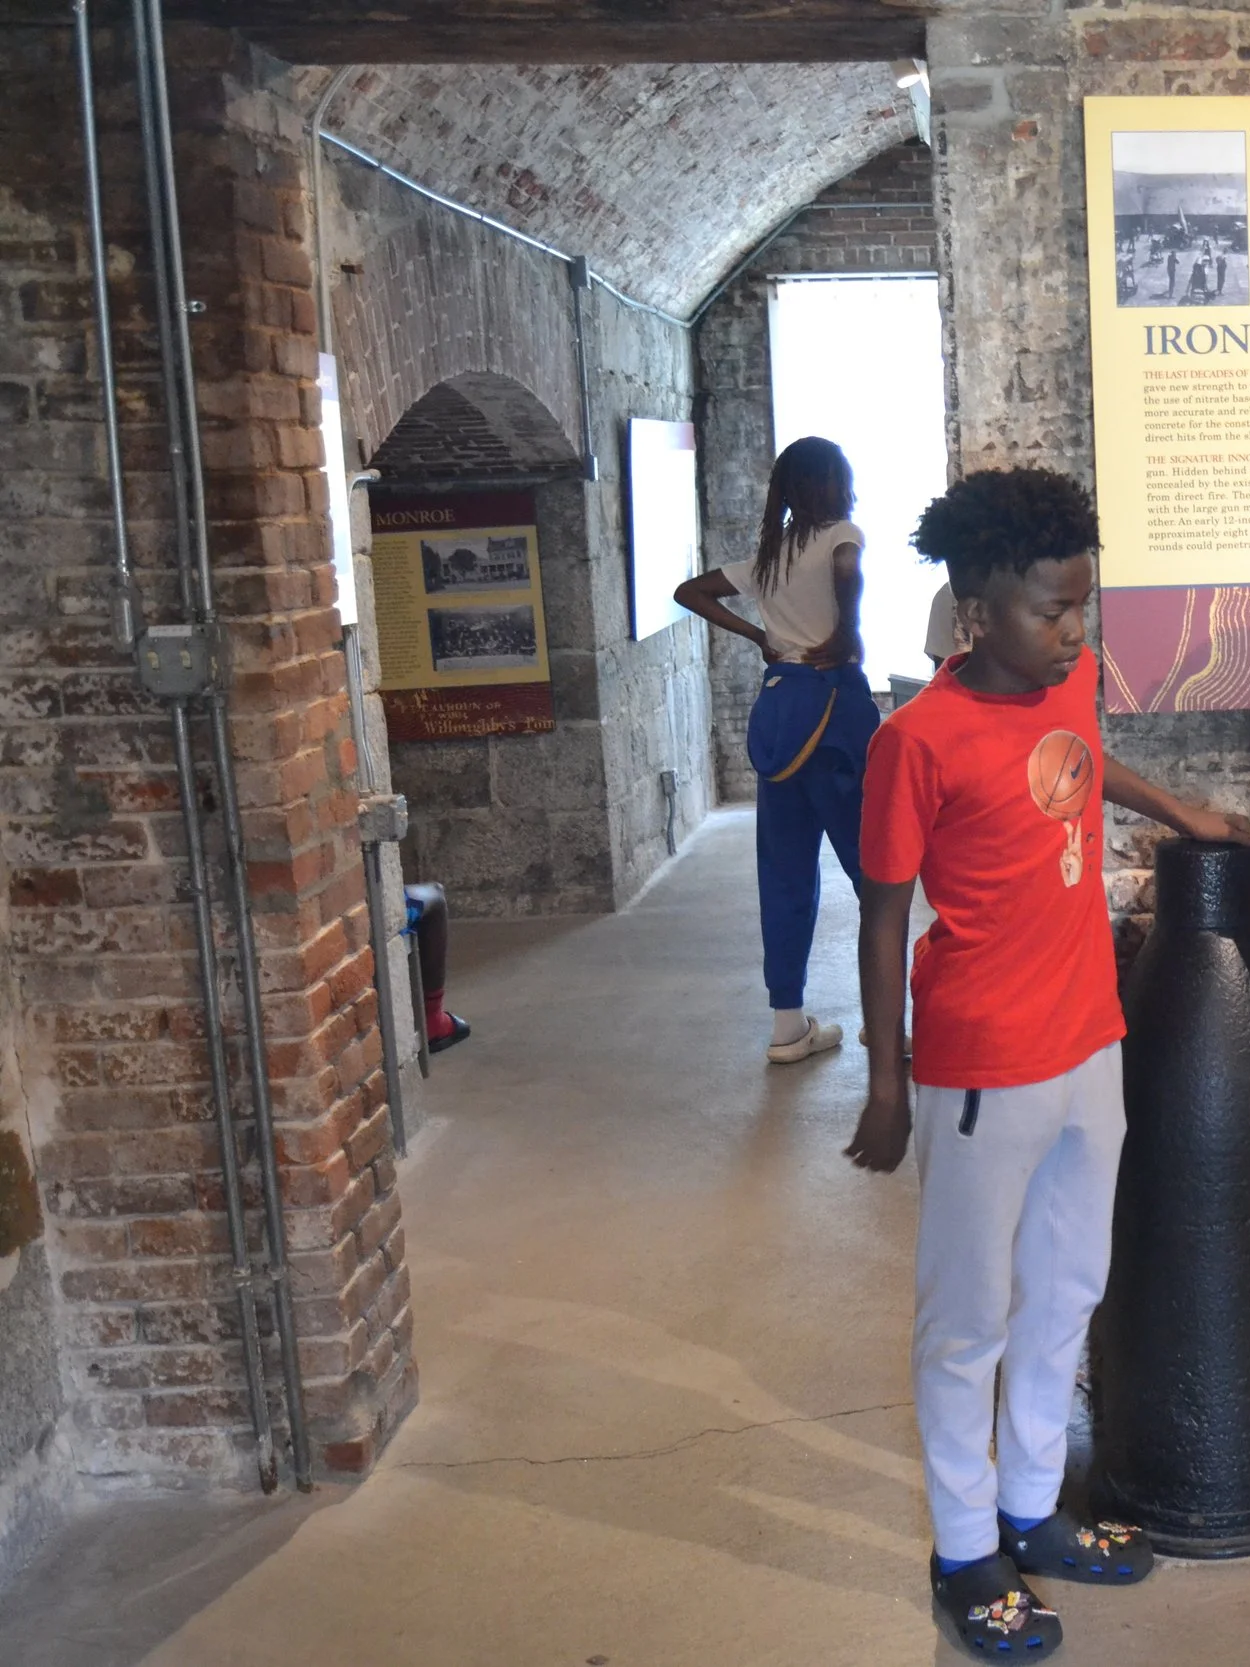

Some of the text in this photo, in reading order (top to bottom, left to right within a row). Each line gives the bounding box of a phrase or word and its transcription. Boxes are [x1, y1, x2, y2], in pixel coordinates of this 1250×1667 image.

[1164, 370, 1188, 378] LAST
[1190, 370, 1234, 378] DECADES
[1235, 369, 1249, 377] OF
[1143, 386, 1167, 395] gave
[1192, 382, 1235, 393] strength
[1144, 396, 1160, 404] the
[1182, 395, 1193, 404] of
[1172, 408, 1215, 416] accurate
[1217, 406, 1236, 415] and
[1188, 420, 1203, 428] for
[1205, 420, 1222, 428] the
[1145, 434, 1174, 442] direct
[1176, 433, 1196, 441] hits
[1199, 432, 1222, 440] from
[1225, 432, 1241, 440] the
[1146, 456, 1166, 464] THE
[1170, 454, 1224, 463] SIGNATURE
[1172, 467, 1209, 476] Hidden
[1212, 466, 1247, 475] behind
[1147, 493, 1170, 501] from
[1174, 492, 1204, 500] direct
[376, 508, 455, 526] MONROE
